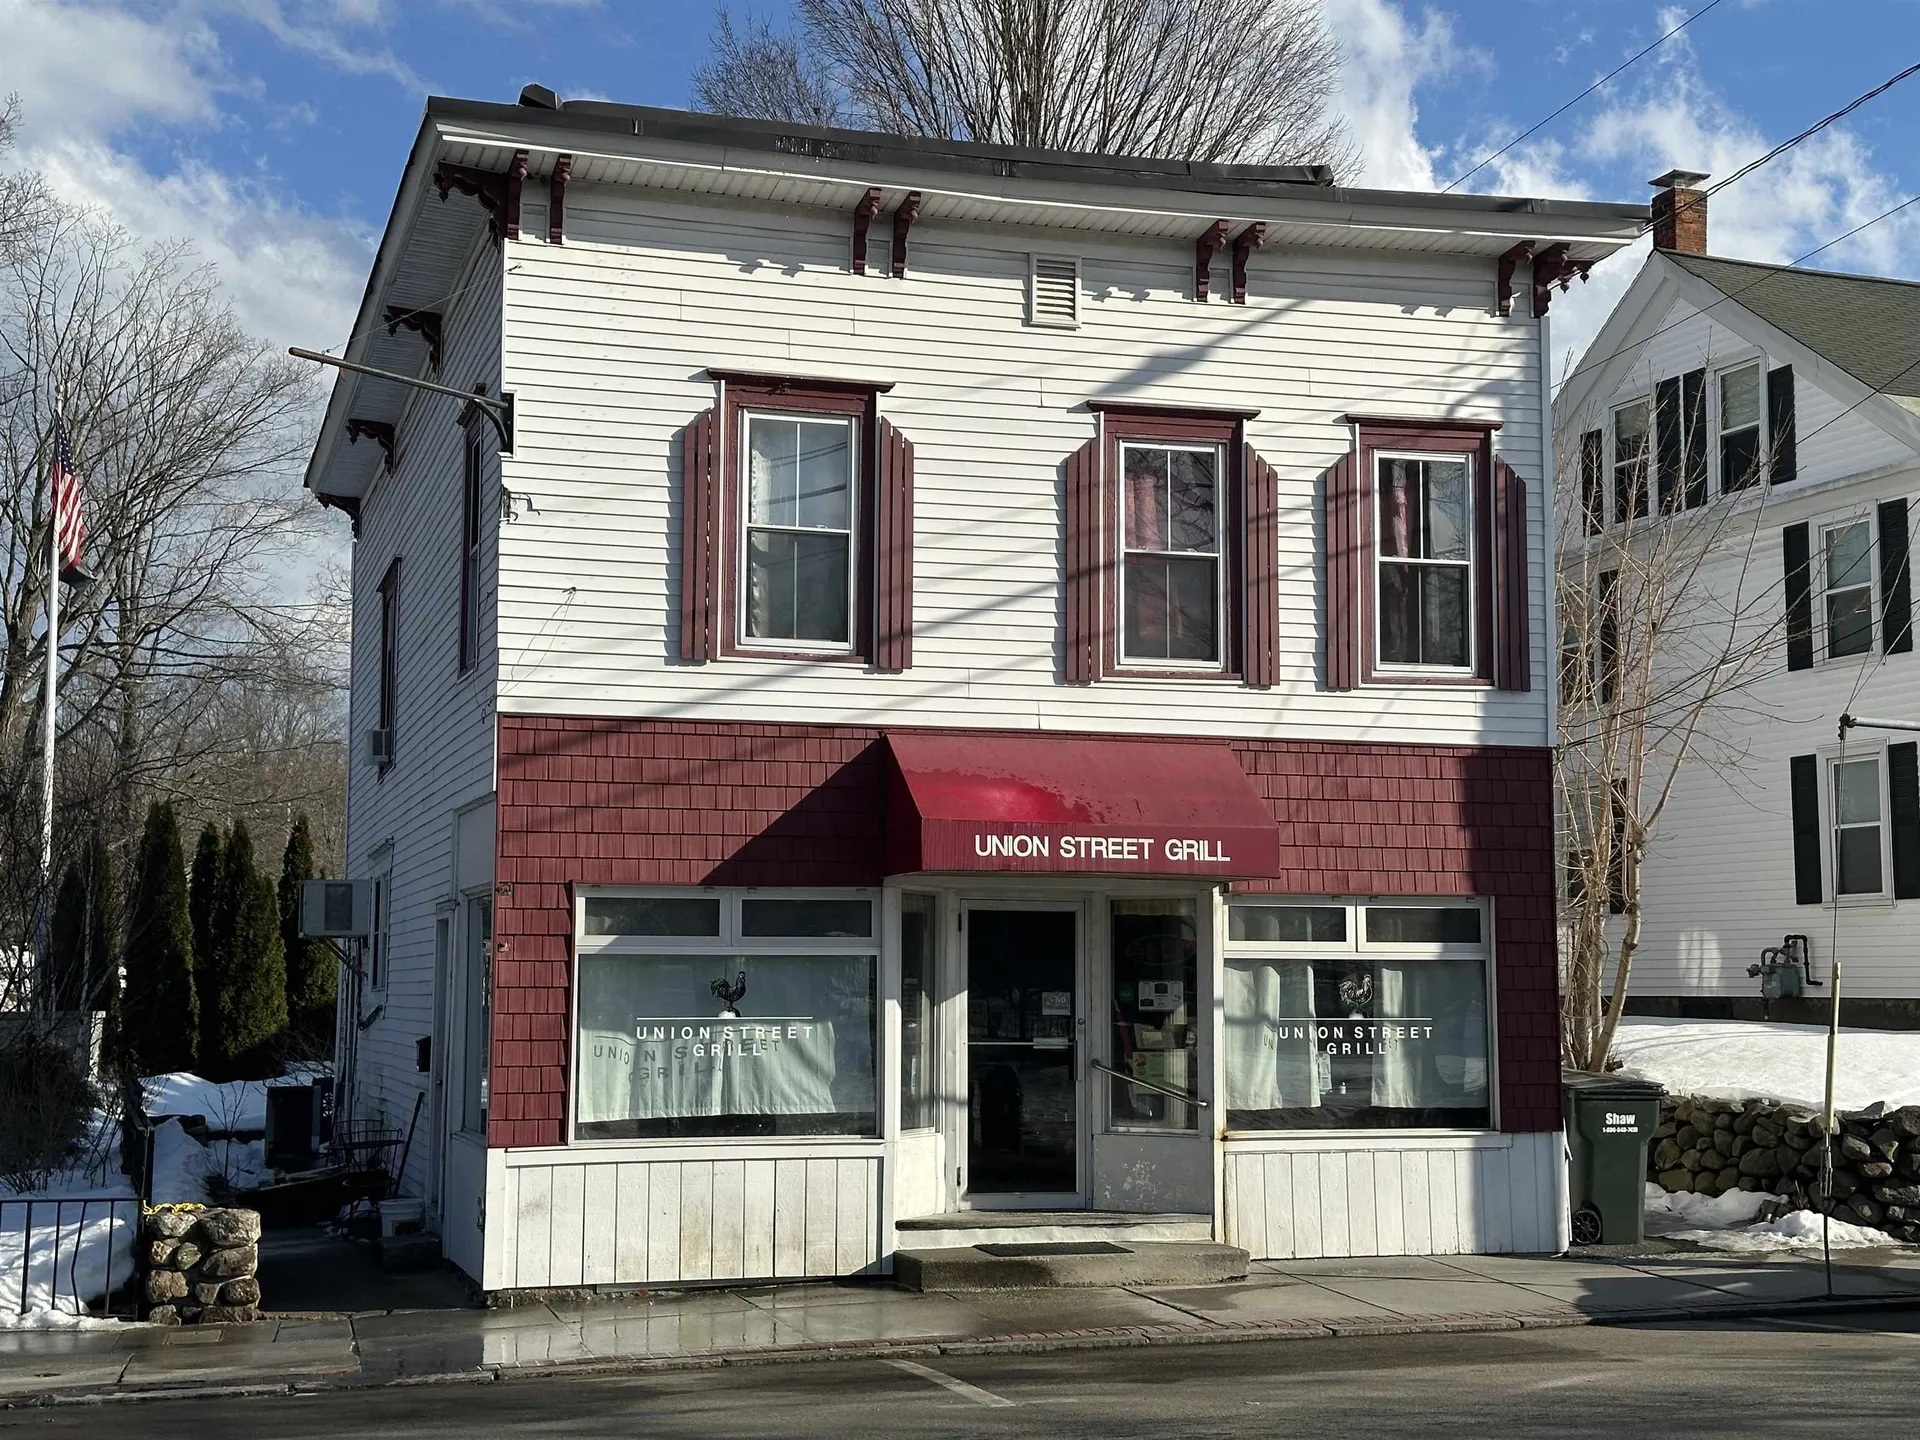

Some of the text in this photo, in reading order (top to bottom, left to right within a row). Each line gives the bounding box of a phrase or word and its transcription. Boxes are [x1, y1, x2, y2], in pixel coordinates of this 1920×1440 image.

[974, 834, 1231, 862] UNION STREET GRILL
[636, 1025, 813, 1040] UNION STREET
[1279, 1026, 1433, 1040] UNION STREET
[693, 1043, 762, 1057] GRILL
[1326, 1042, 1388, 1056] GRILL
[1605, 1112, 1636, 1125] Shaw
